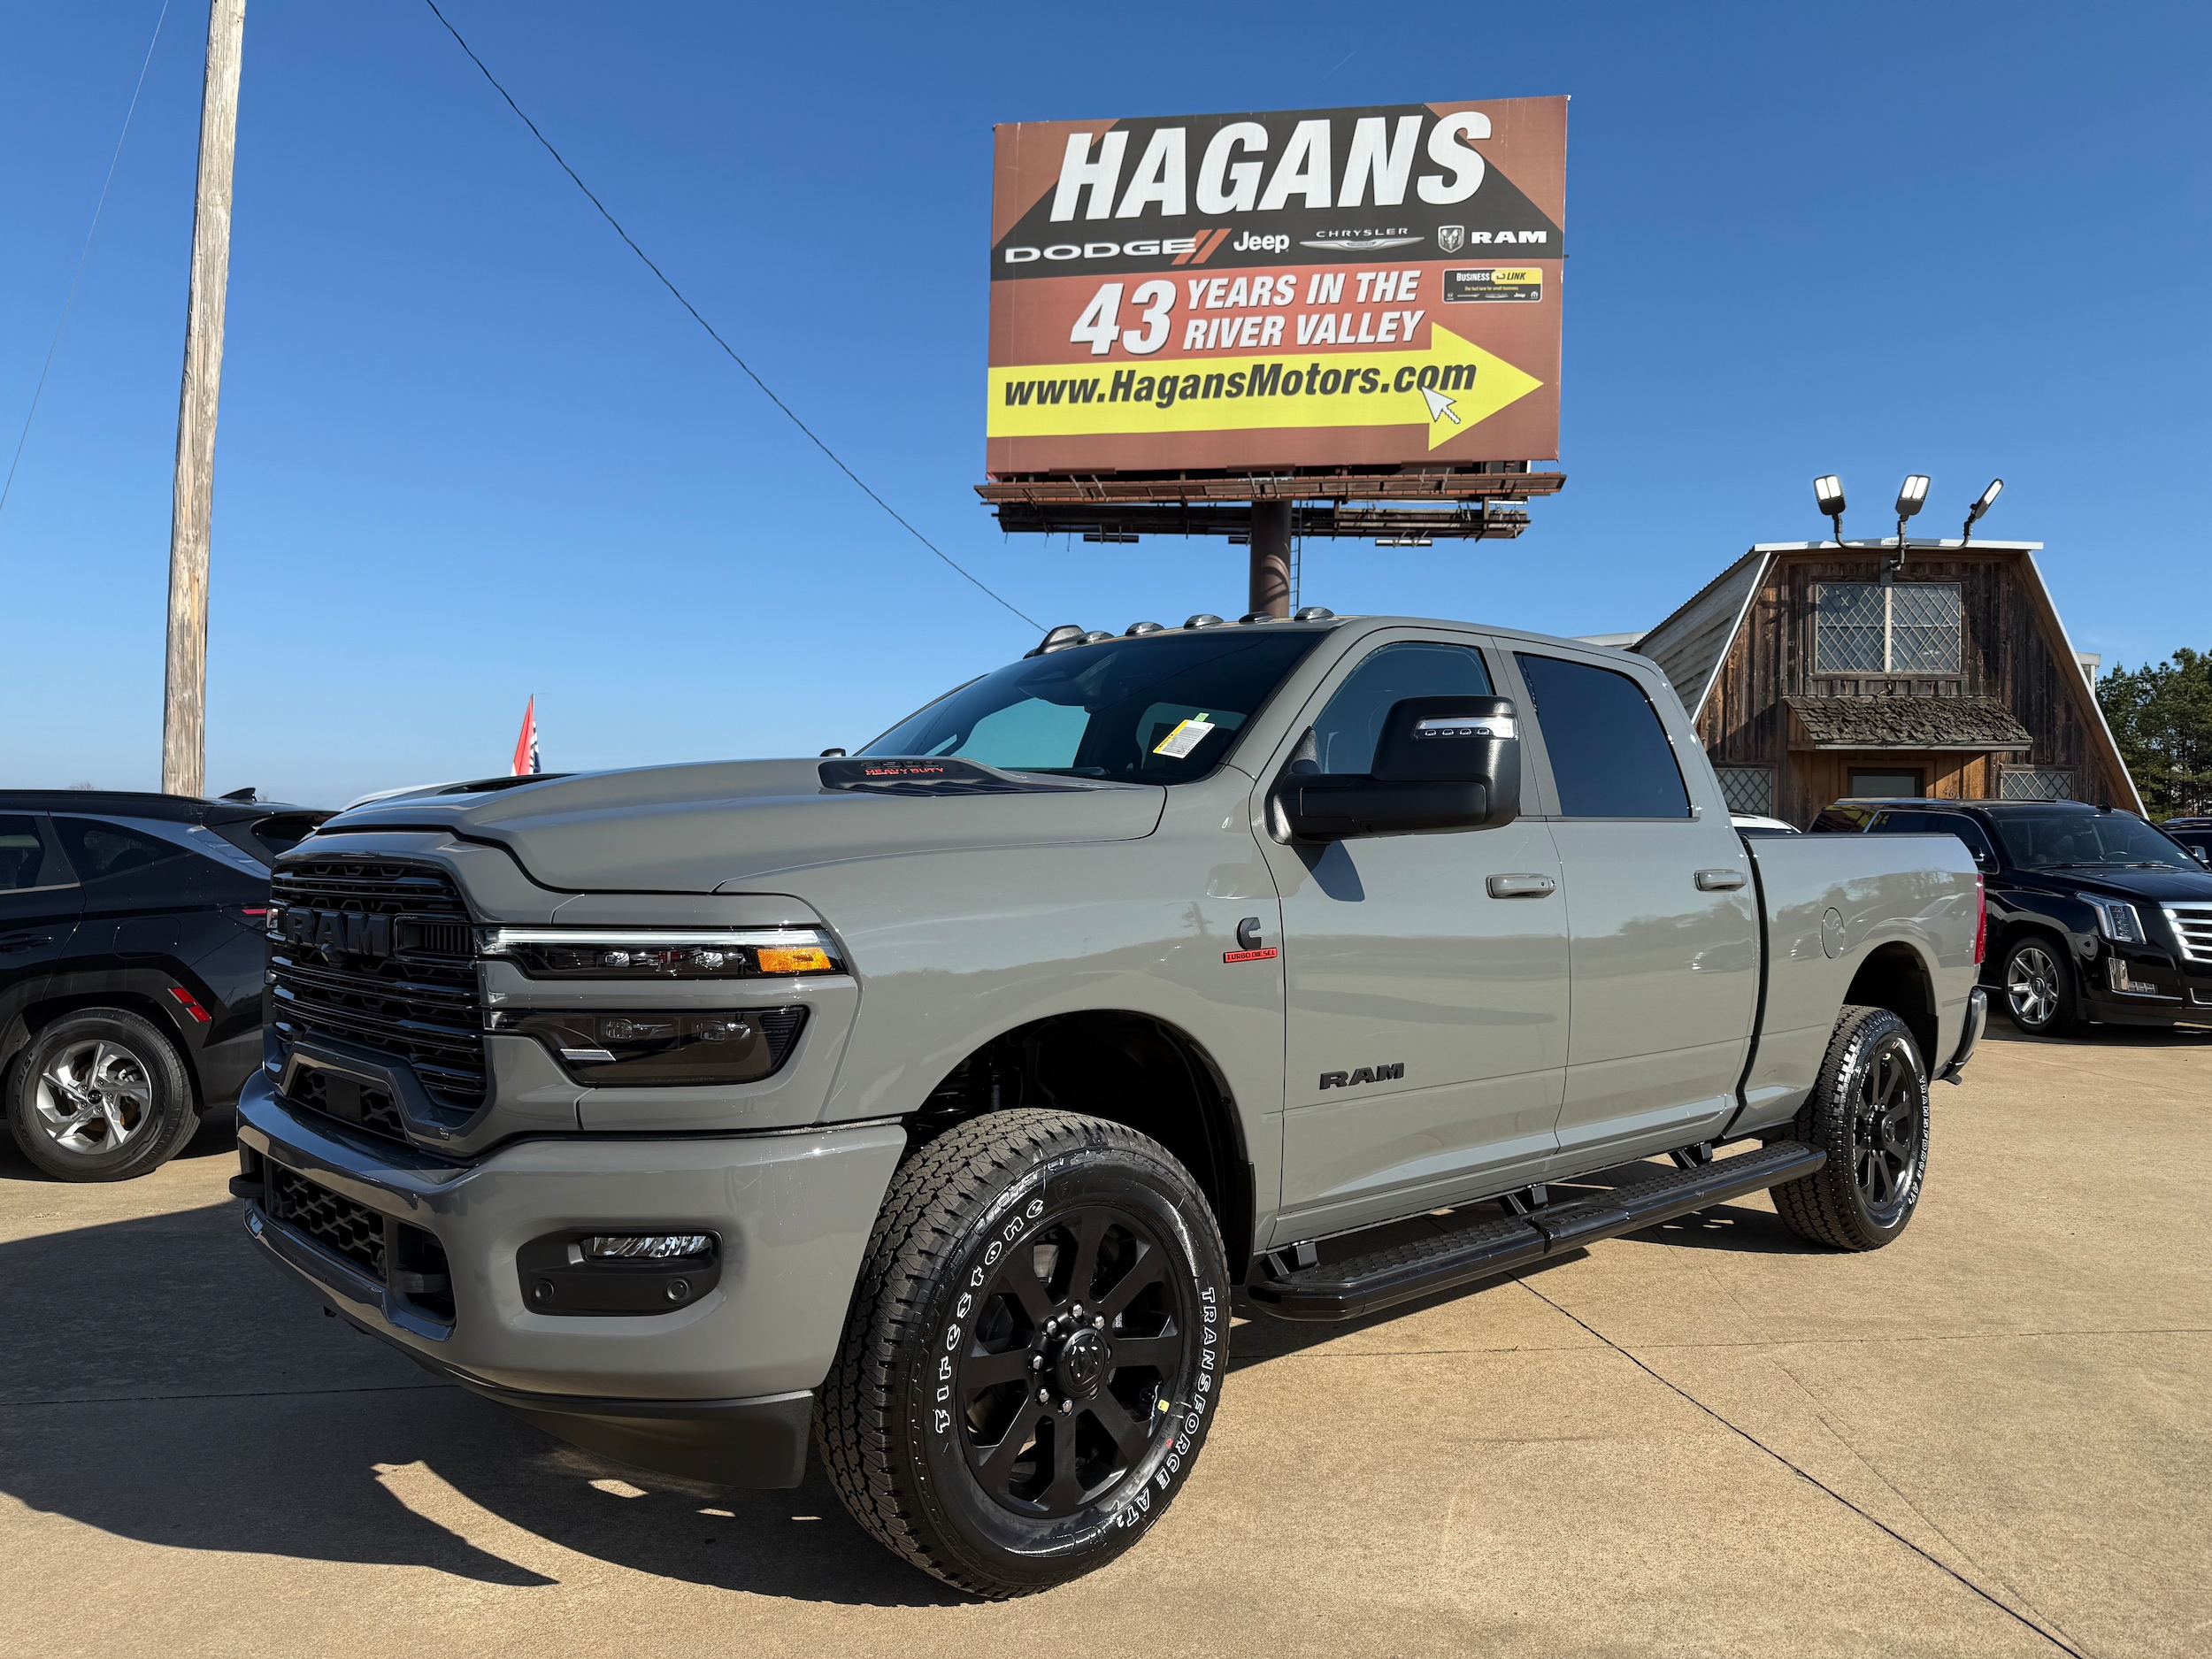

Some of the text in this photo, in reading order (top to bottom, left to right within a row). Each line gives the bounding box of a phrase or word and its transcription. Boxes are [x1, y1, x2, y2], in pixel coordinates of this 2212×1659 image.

[1048, 111, 1493, 223] HAGANS
[1004, 227, 1548, 264] DODGE Jeep CHRYSLER RAM
[1187, 269, 1422, 311] YEARS IN THE
[1455, 272, 1526, 281] BUSINESS LINK
[1068, 279, 1177, 356] 43
[1182, 310, 1425, 351] RIVER VALLEY
[1005, 363, 1477, 409] www.HagansMotors.com
[287, 907, 389, 956] RAM
[1226, 952, 1251, 961] TURBO
[1318, 1062, 1405, 1090] RAM
[1156, 1286, 1217, 1491] TRANSFORCE
